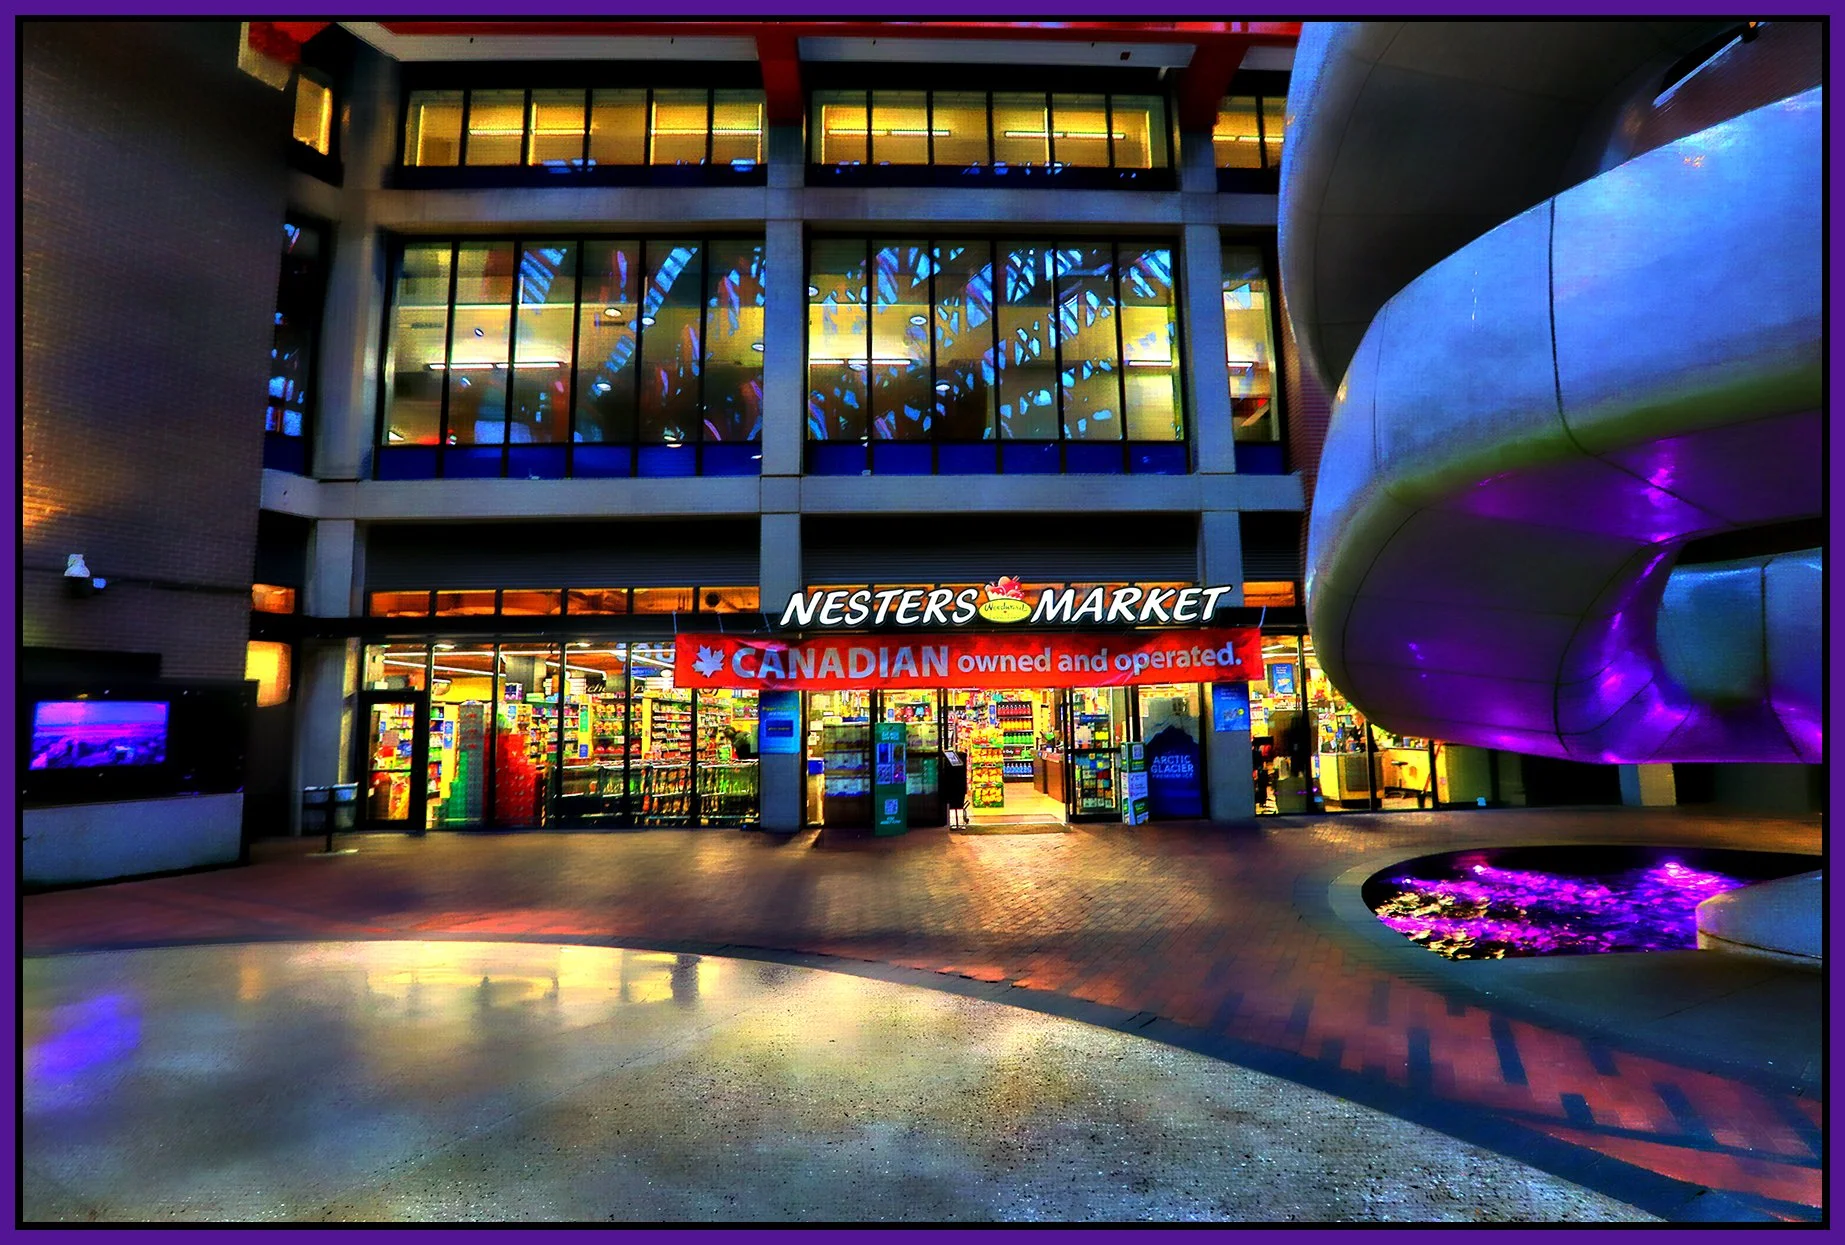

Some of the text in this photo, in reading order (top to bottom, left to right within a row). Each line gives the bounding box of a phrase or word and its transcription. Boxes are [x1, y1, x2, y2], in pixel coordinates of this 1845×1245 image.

[780, 586, 1232, 626] NESTERS MARKET
[731, 641, 1242, 679] CANADIAN owned and operated.
[1151, 764, 1194, 773] GLACIER
[1153, 755, 1192, 764] ARCTIC
